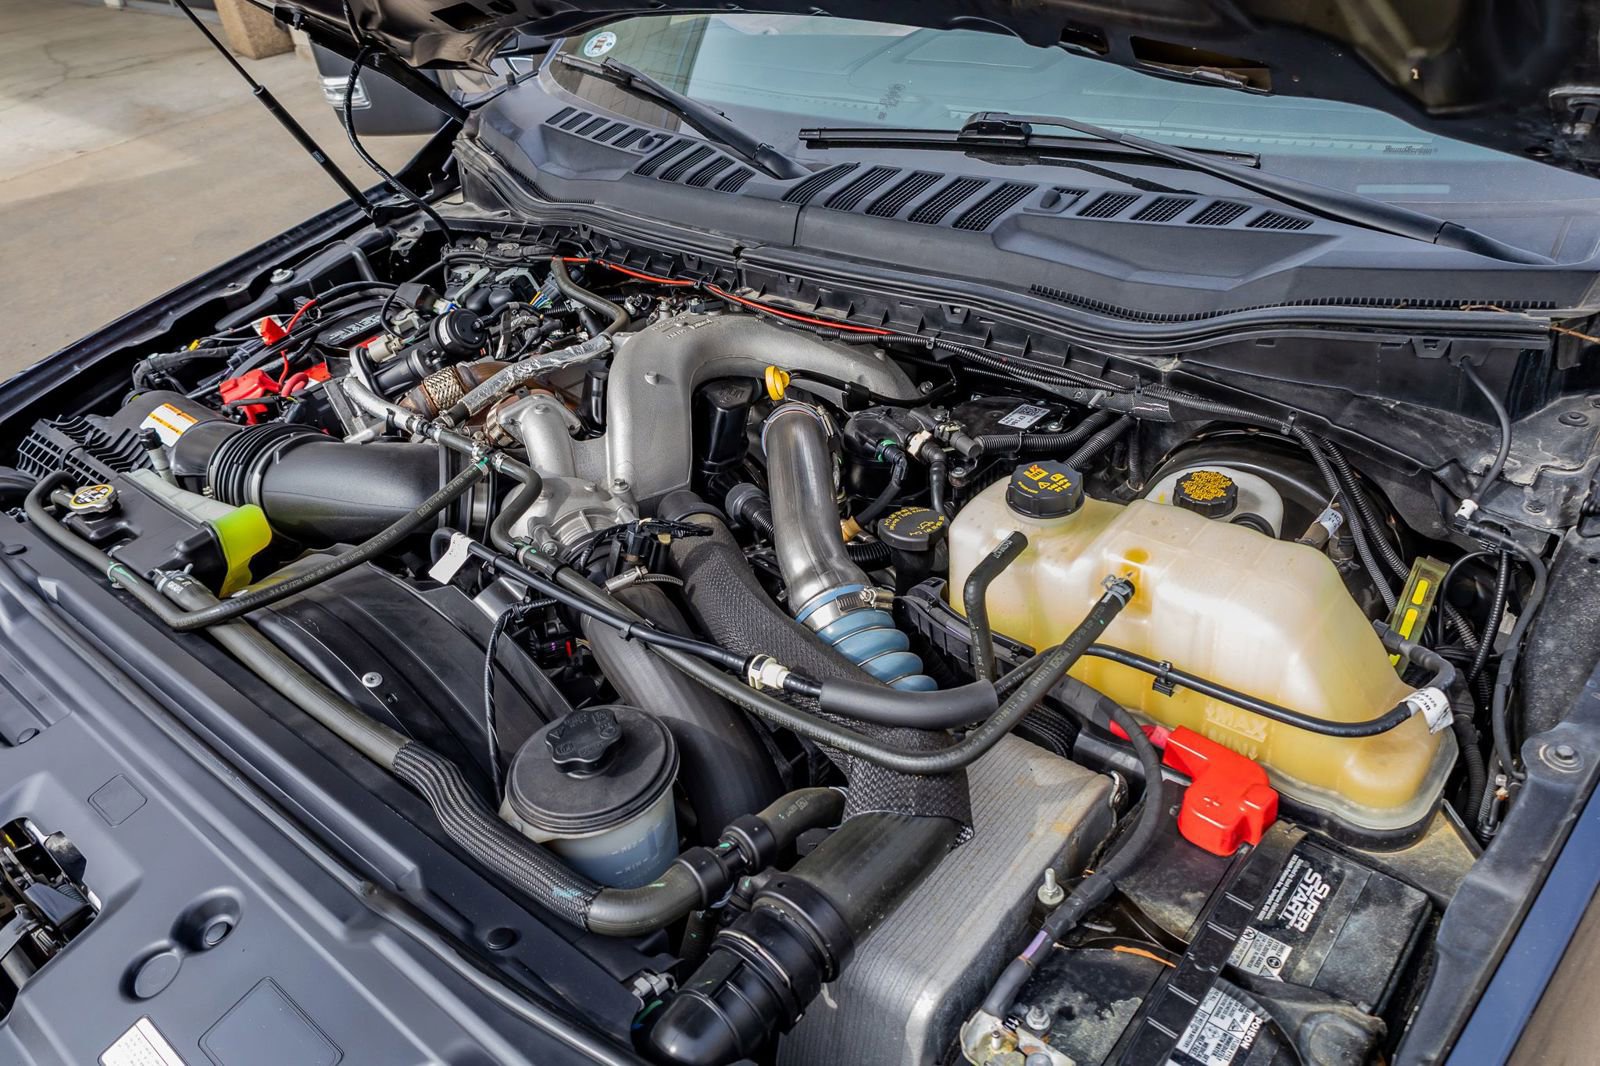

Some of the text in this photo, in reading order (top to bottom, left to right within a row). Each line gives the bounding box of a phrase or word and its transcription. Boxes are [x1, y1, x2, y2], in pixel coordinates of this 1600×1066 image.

[1282, 867, 1321, 927] START
[1292, 882, 1330, 933] SUPER
[1259, 938, 1273, 957] EXPLOSIVE
[1197, 1034, 1205, 1045] HELP
[1219, 1032, 1227, 1043] WITH
[1239, 1015, 1263, 1049] POISON
[1196, 1041, 1208, 1059] MEDICAL
[1215, 1035, 1233, 1061] IMMEDIATELY
